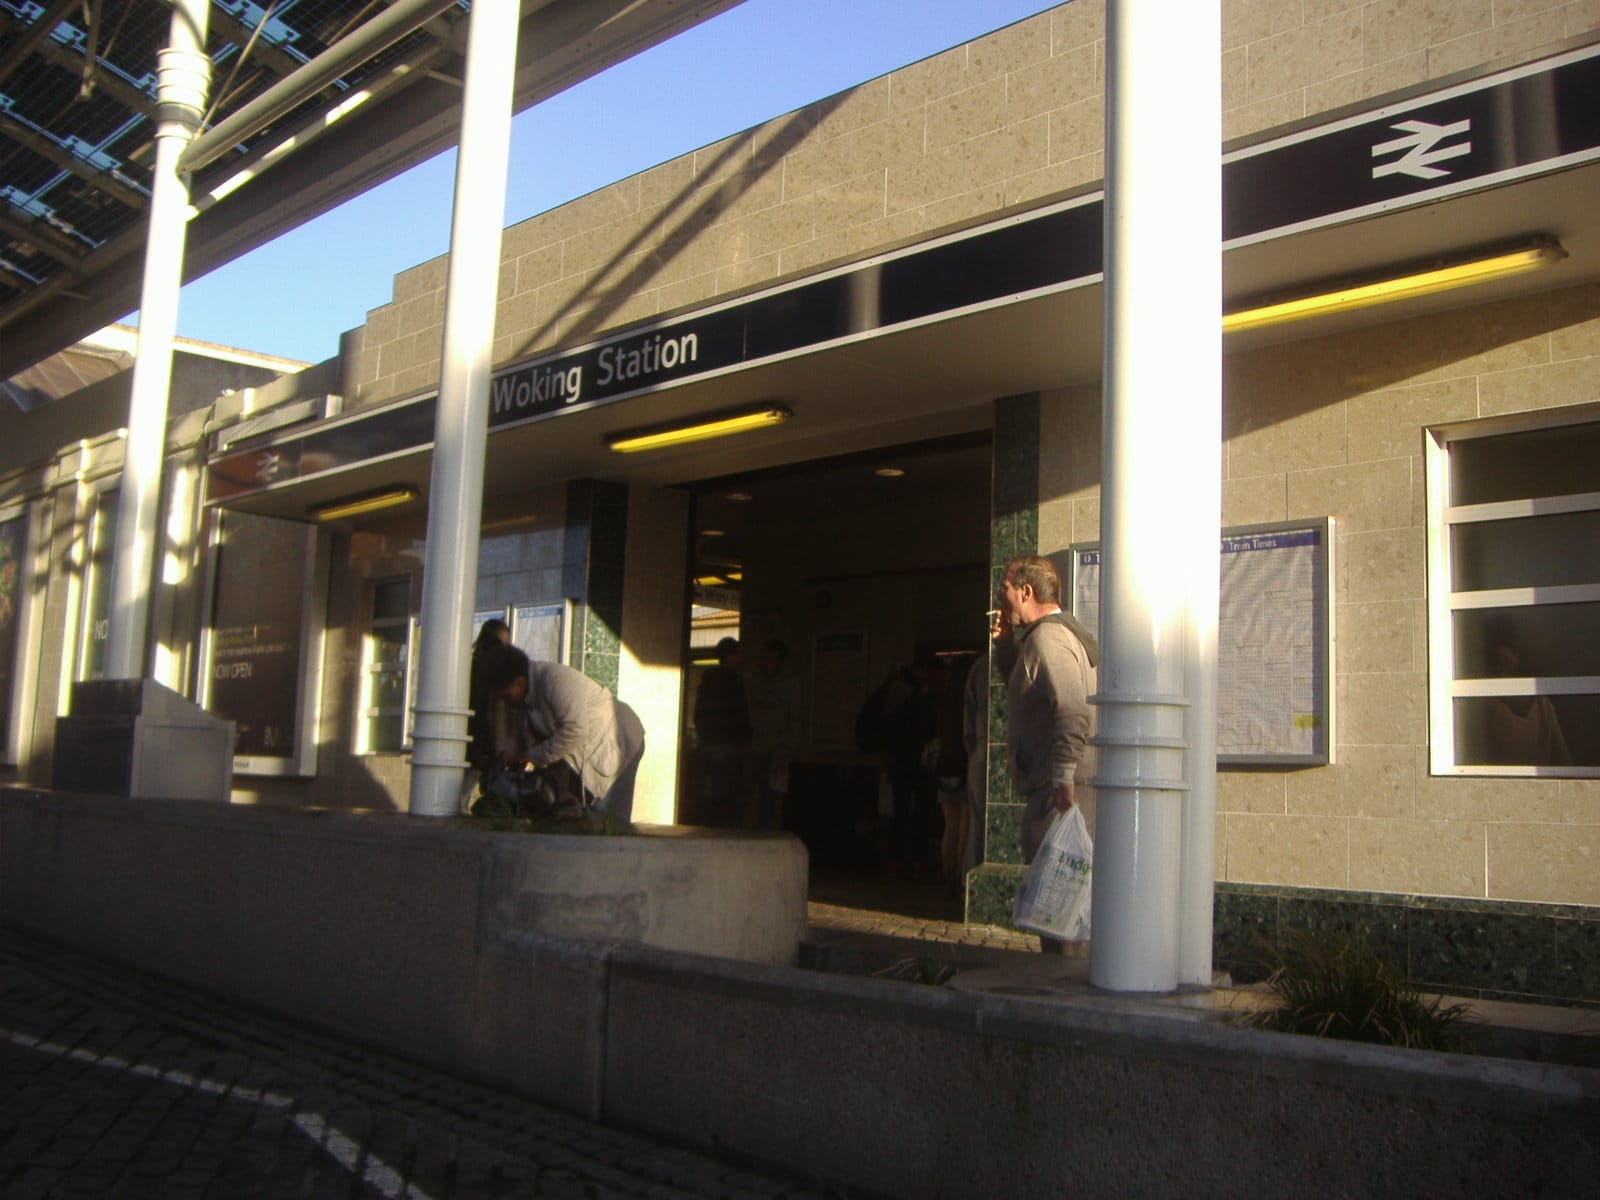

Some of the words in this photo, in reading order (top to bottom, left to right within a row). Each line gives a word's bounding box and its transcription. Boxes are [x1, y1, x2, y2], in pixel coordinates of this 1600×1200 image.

[493, 365, 583, 413] Woking
[597, 332, 698, 386] Station
[1252, 539, 1277, 550] Times
